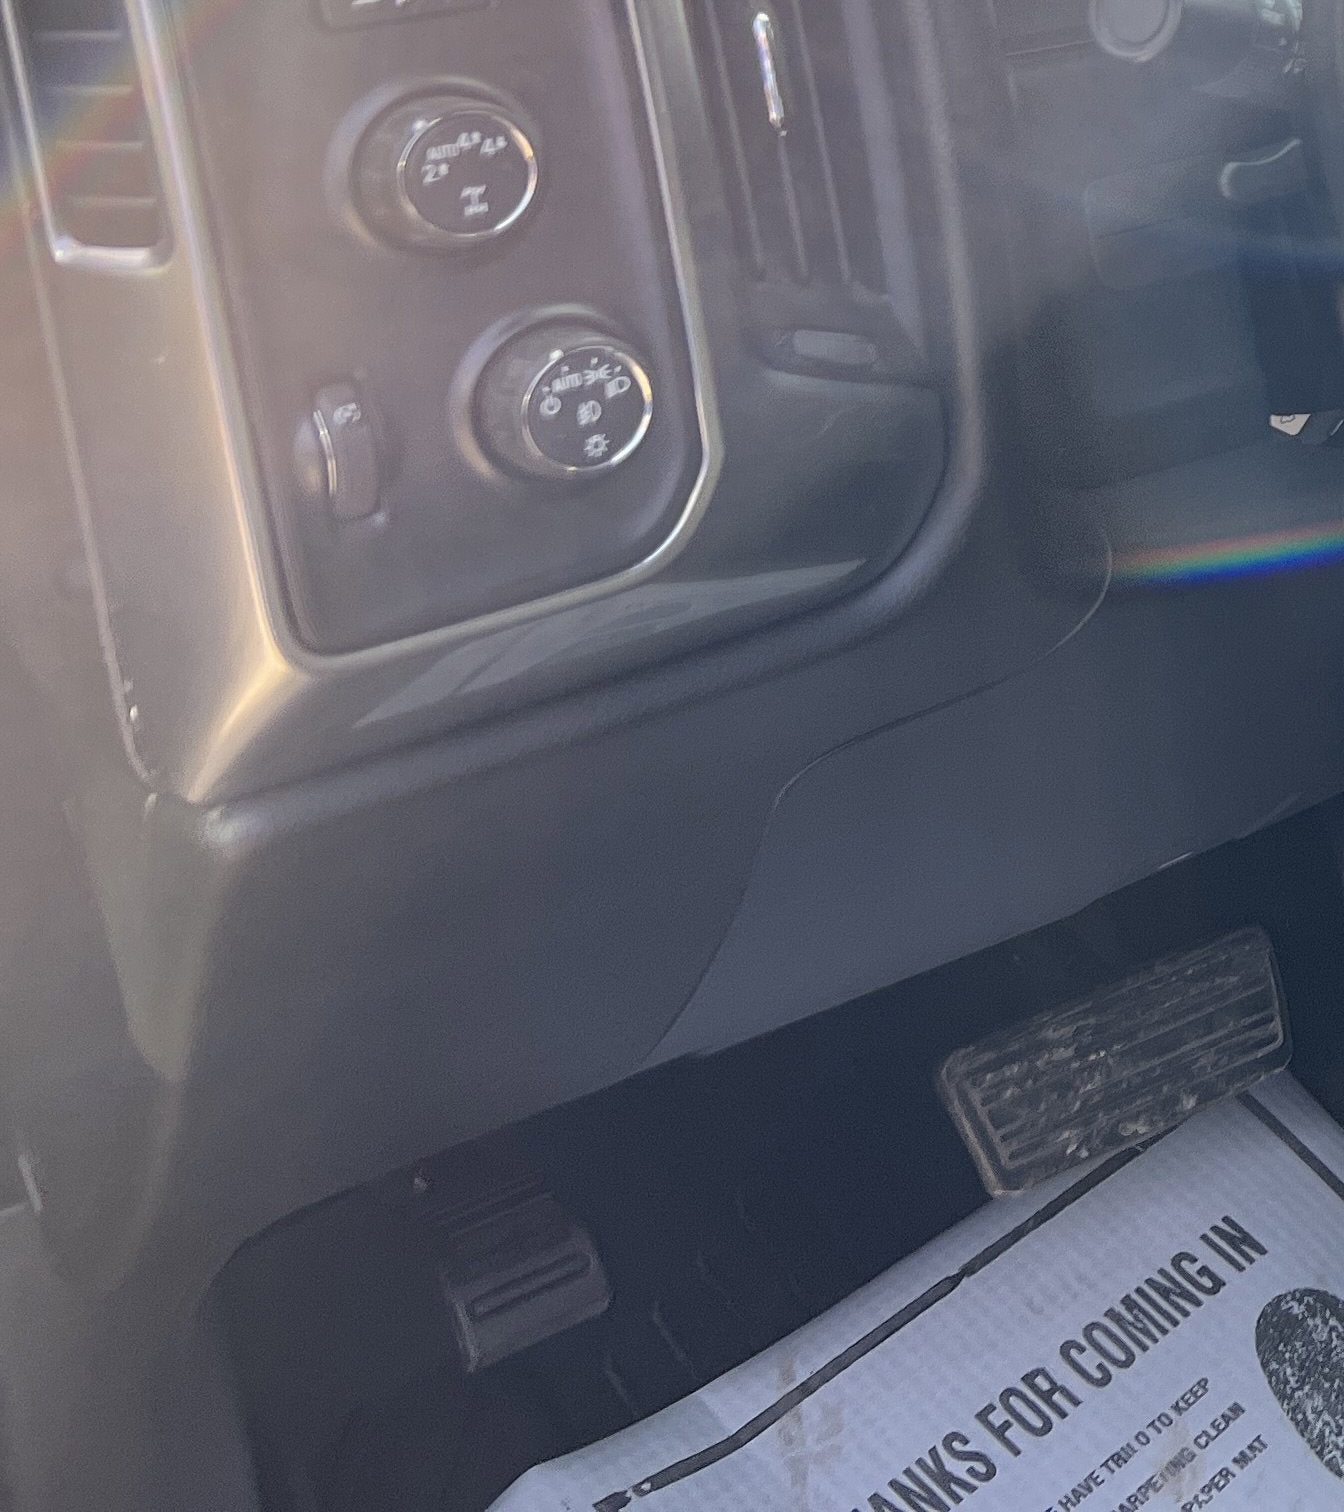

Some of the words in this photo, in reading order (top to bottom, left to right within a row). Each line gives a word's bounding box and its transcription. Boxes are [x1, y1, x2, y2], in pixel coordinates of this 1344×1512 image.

[553, 372, 583, 392] AUTO
[851, 1431, 998, 1512] ANKS
[974, 1366, 1083, 1458] FOR
[1059, 1251, 1227, 1388] COMING
[1199, 1214, 1269, 1273] IN
[1057, 1469, 1106, 1512] HAVE
[1146, 1411, 1174, 1435] TO
[1170, 1376, 1210, 1417] KEEP
[1193, 1400, 1246, 1451] CLEAN
[1181, 1466, 1237, 1512] PAPER
[1231, 1432, 1269, 1471] MAT
